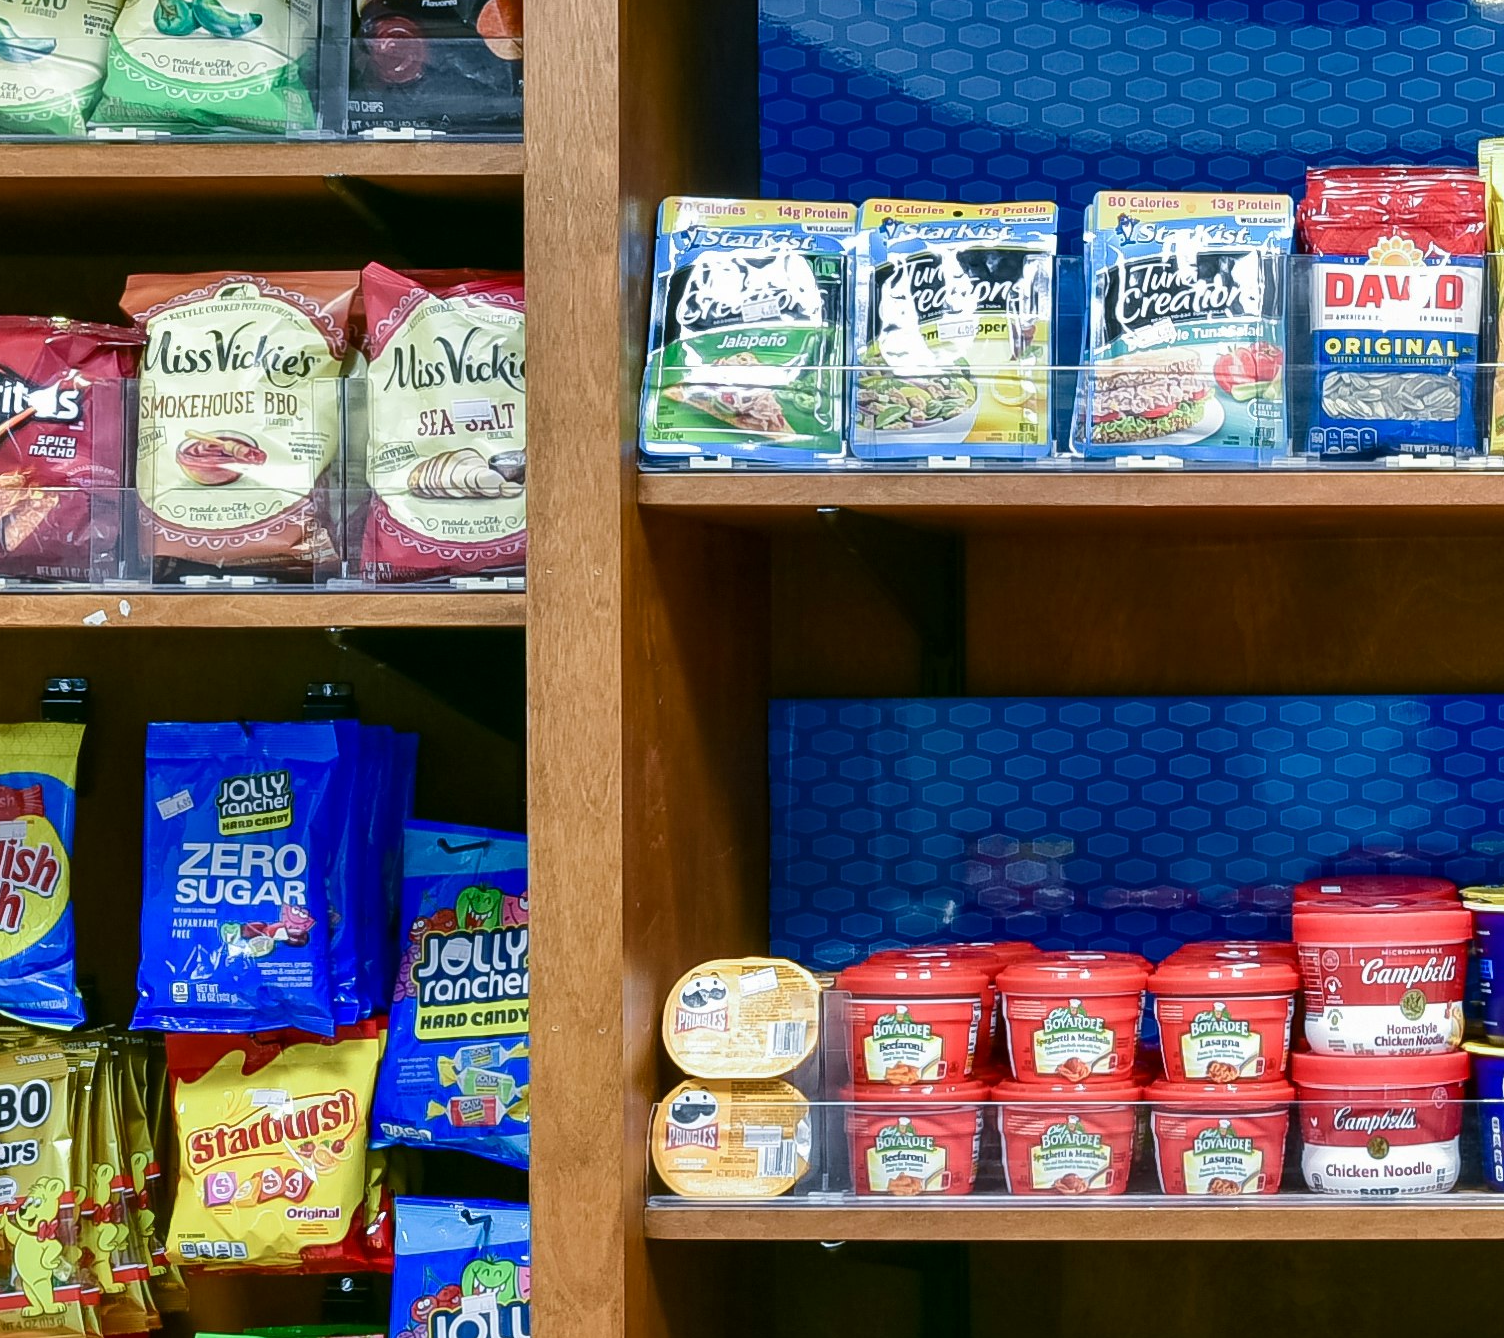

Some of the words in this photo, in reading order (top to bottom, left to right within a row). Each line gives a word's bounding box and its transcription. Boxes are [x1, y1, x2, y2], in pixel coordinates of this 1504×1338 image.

[1108, 196, 1129, 208] 80
[1133, 197, 1179, 209] Calories
[1210, 198, 1234, 213] 13g
[1238, 198, 1283, 211] Protein
[896, 222, 1012, 242] StarKist
[208, 322, 316, 378] Vickie's
[717, 332, 788, 349] Jalapeño
[1324, 337, 1460, 358] ORIGINAL
[141, 392, 256, 420] SMOKEHOUSE
[264, 391, 299, 420] BBQ
[418, 409, 454, 436] SEA
[37, 435, 76, 447] SPICY
[29, 446, 76, 459] NACHO
[219, 773, 291, 804] JOLLY
[221, 793, 291, 817] rancher
[222, 820, 251, 832] HARD
[254, 813, 290, 829] CANDY
[178, 842, 307, 878] ZERO
[175, 879, 306, 906] SUGAR
[172, 918, 218, 930] ASPARTAME
[172, 929, 191, 939] FREE
[1381, 947, 1443, 955] MICROWAVABLE
[1360, 957, 1456, 986] Campbell's
[420, 1011, 462, 1031] HARD
[676, 1009, 729, 1032] PRINGLES
[1387, 1023, 1438, 1035] Homestyle
[873, 1023, 932, 1039] BOYARDEE
[1374, 1035, 1410, 1046] Chicken
[1412, 1034, 1445, 1046] Noodle
[1199, 1039, 1240, 1050] Lasagna
[191, 1091, 355, 1164] Starburst
[1333, 1106, 1417, 1134] Campbell's
[1326, 1163, 1380, 1178] Chicken
[1384, 1161, 1432, 1176] Noodle
[286, 1206, 341, 1220] Original
